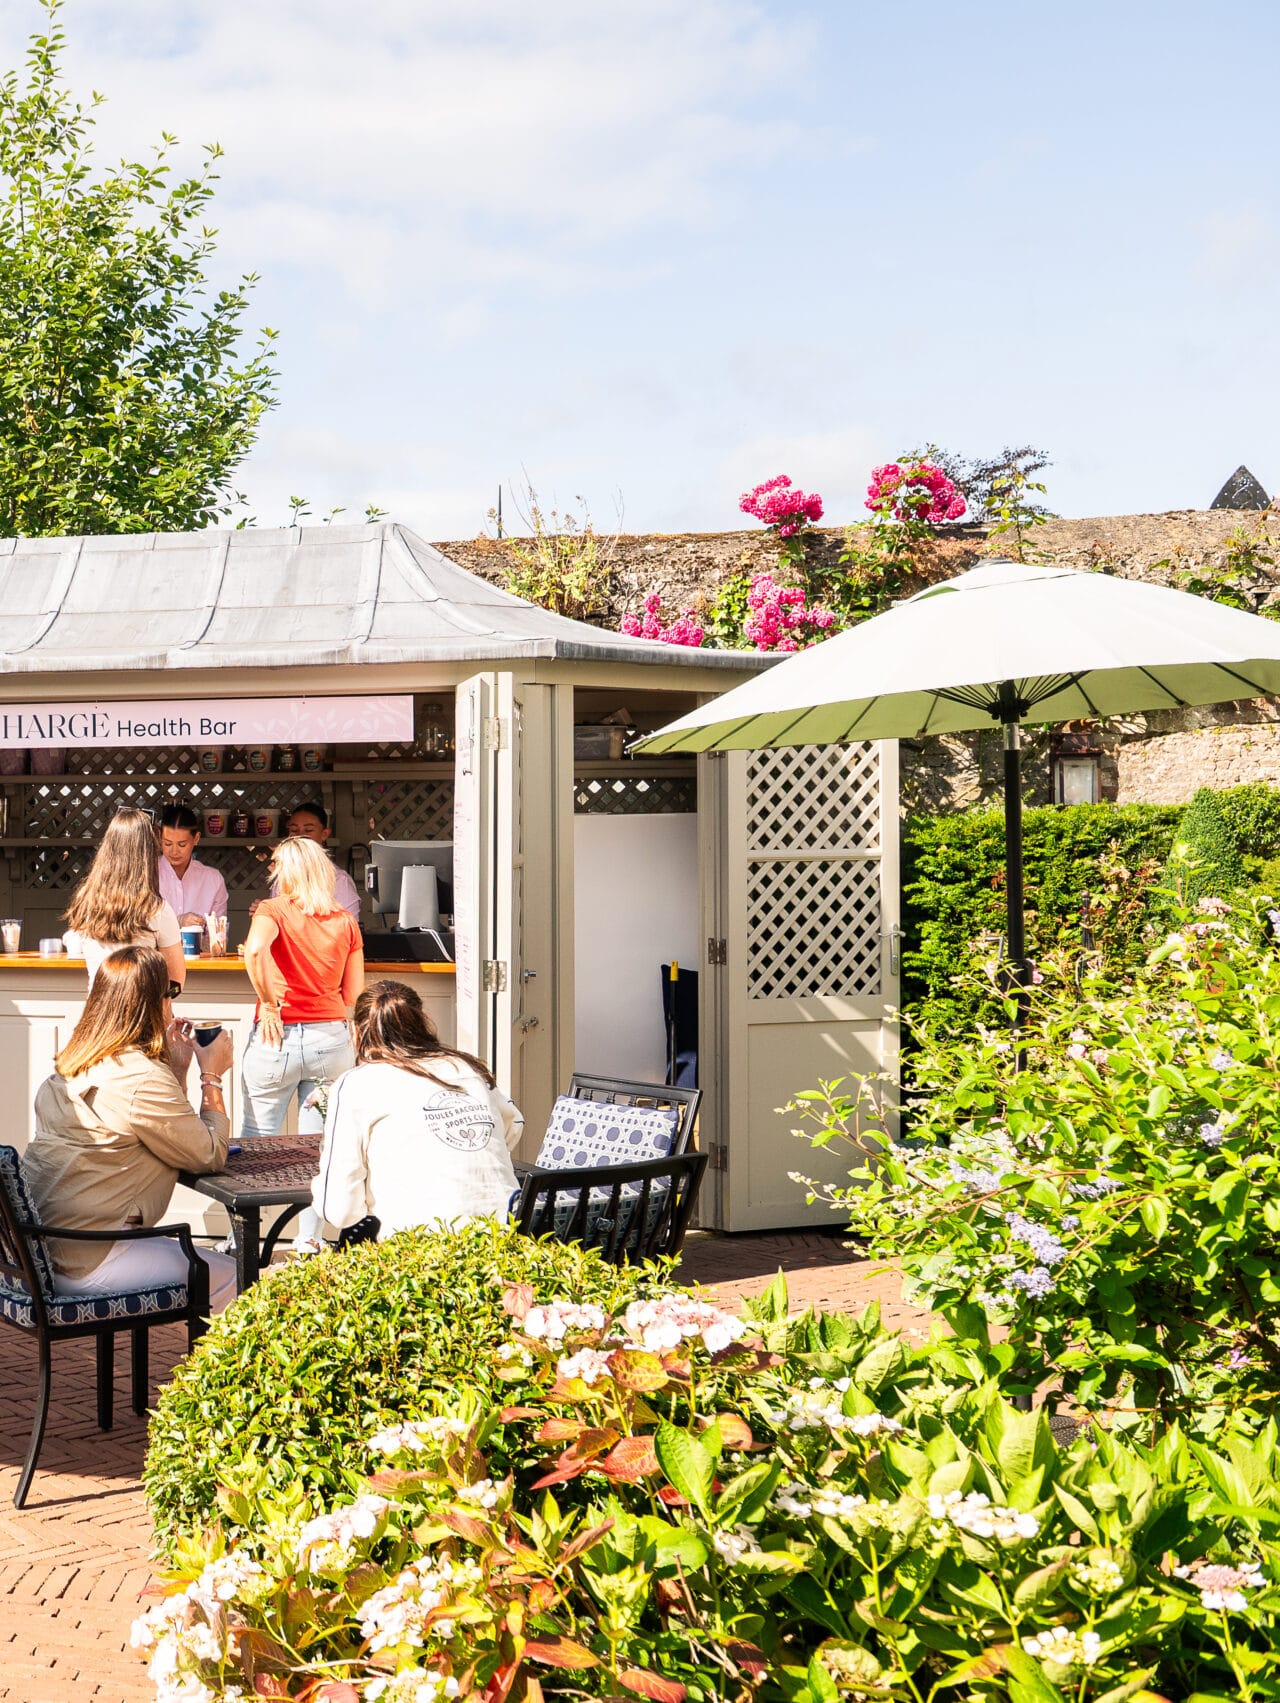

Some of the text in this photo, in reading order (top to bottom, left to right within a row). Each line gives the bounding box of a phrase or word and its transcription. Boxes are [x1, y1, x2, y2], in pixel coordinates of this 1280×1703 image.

[117, 717, 191, 737] Health
[200, 718, 237, 736] Bar
[424, 1104, 488, 1121] JOULES RACQUET
[445, 1116, 473, 1129] SPORTS
[473, 1114, 493, 1122] CLUB
